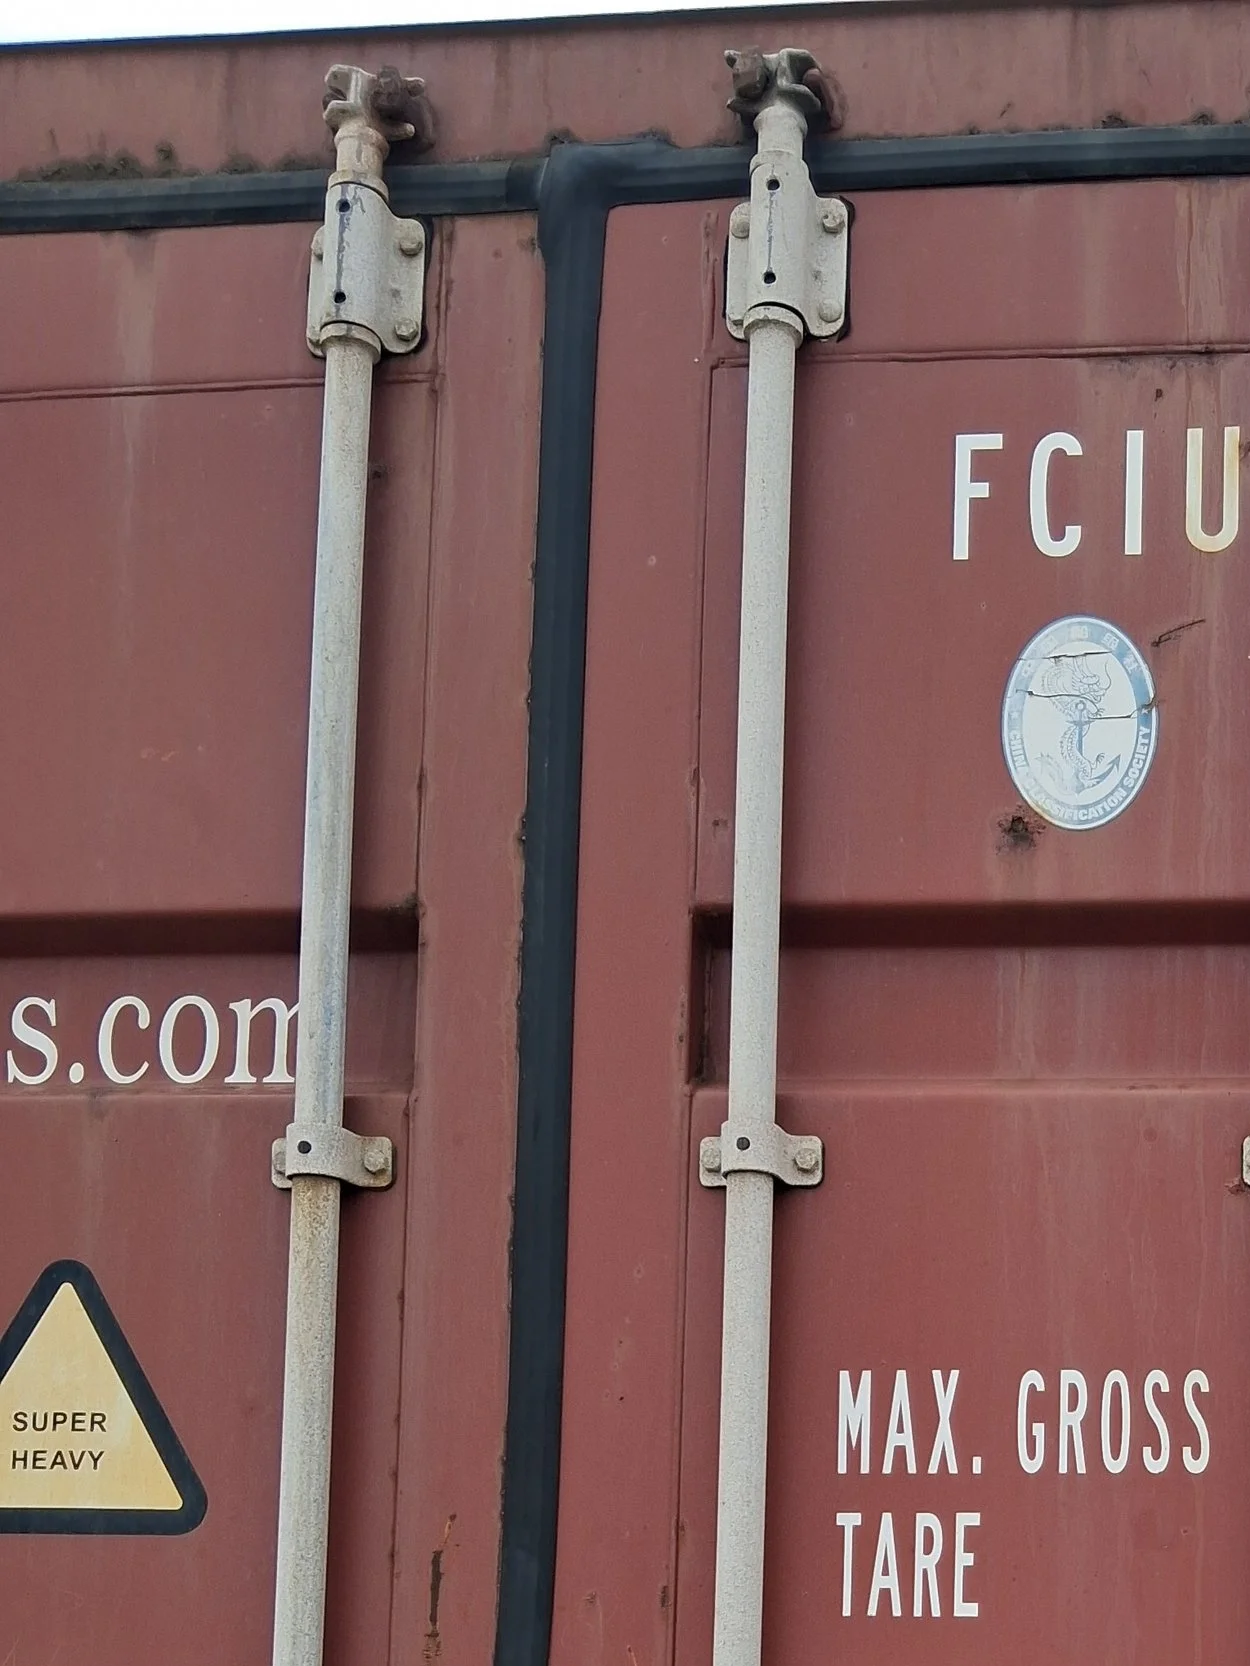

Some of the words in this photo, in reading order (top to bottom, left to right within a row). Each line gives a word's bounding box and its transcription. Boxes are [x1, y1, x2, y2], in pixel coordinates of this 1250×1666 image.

[953, 426, 1240, 560] FCIU
[1122, 727, 1151, 787] SOCIETY
[7, 995, 298, 1086] s.com
[11, 1449, 105, 1470] HEAVY
[12, 1411, 107, 1432] SUPER
[838, 1370, 981, 1475] MAX.
[1018, 1370, 1210, 1475] GROSS
[836, 1512, 980, 1617] TARE
